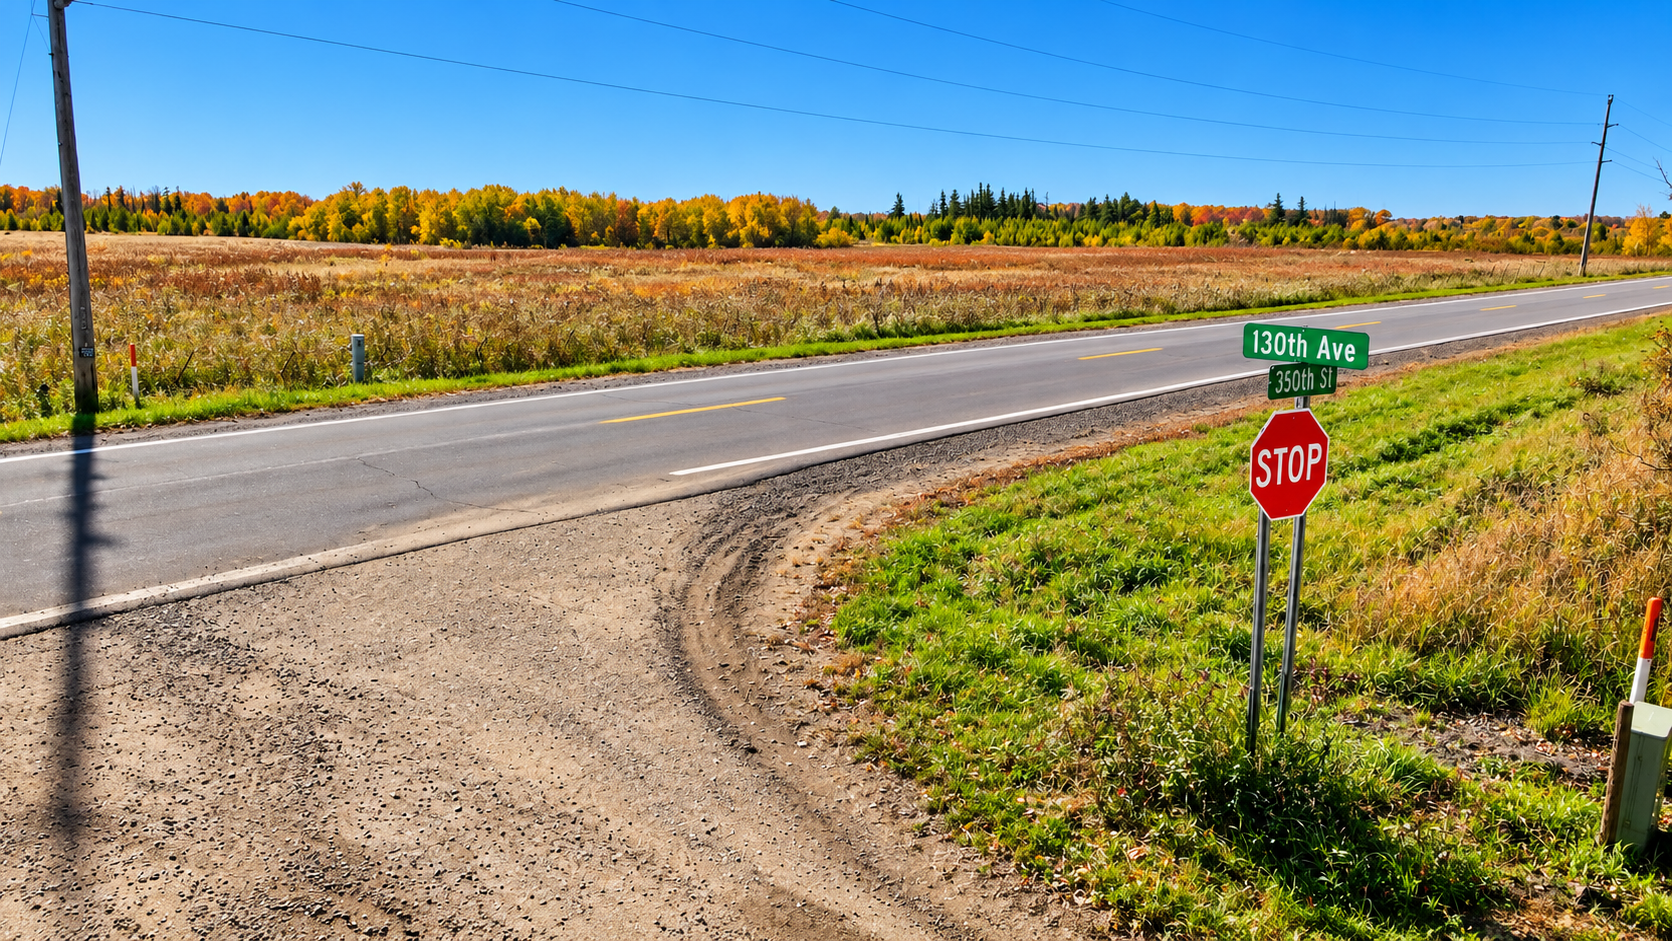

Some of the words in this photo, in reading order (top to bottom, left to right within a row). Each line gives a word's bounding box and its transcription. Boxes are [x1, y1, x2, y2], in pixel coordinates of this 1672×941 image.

[1253, 329, 1307, 358] 130th
[1316, 335, 1356, 362] Ave
[1275, 367, 1314, 394] 350th
[1320, 366, 1333, 388] St
[1256, 443, 1322, 488] STOP
